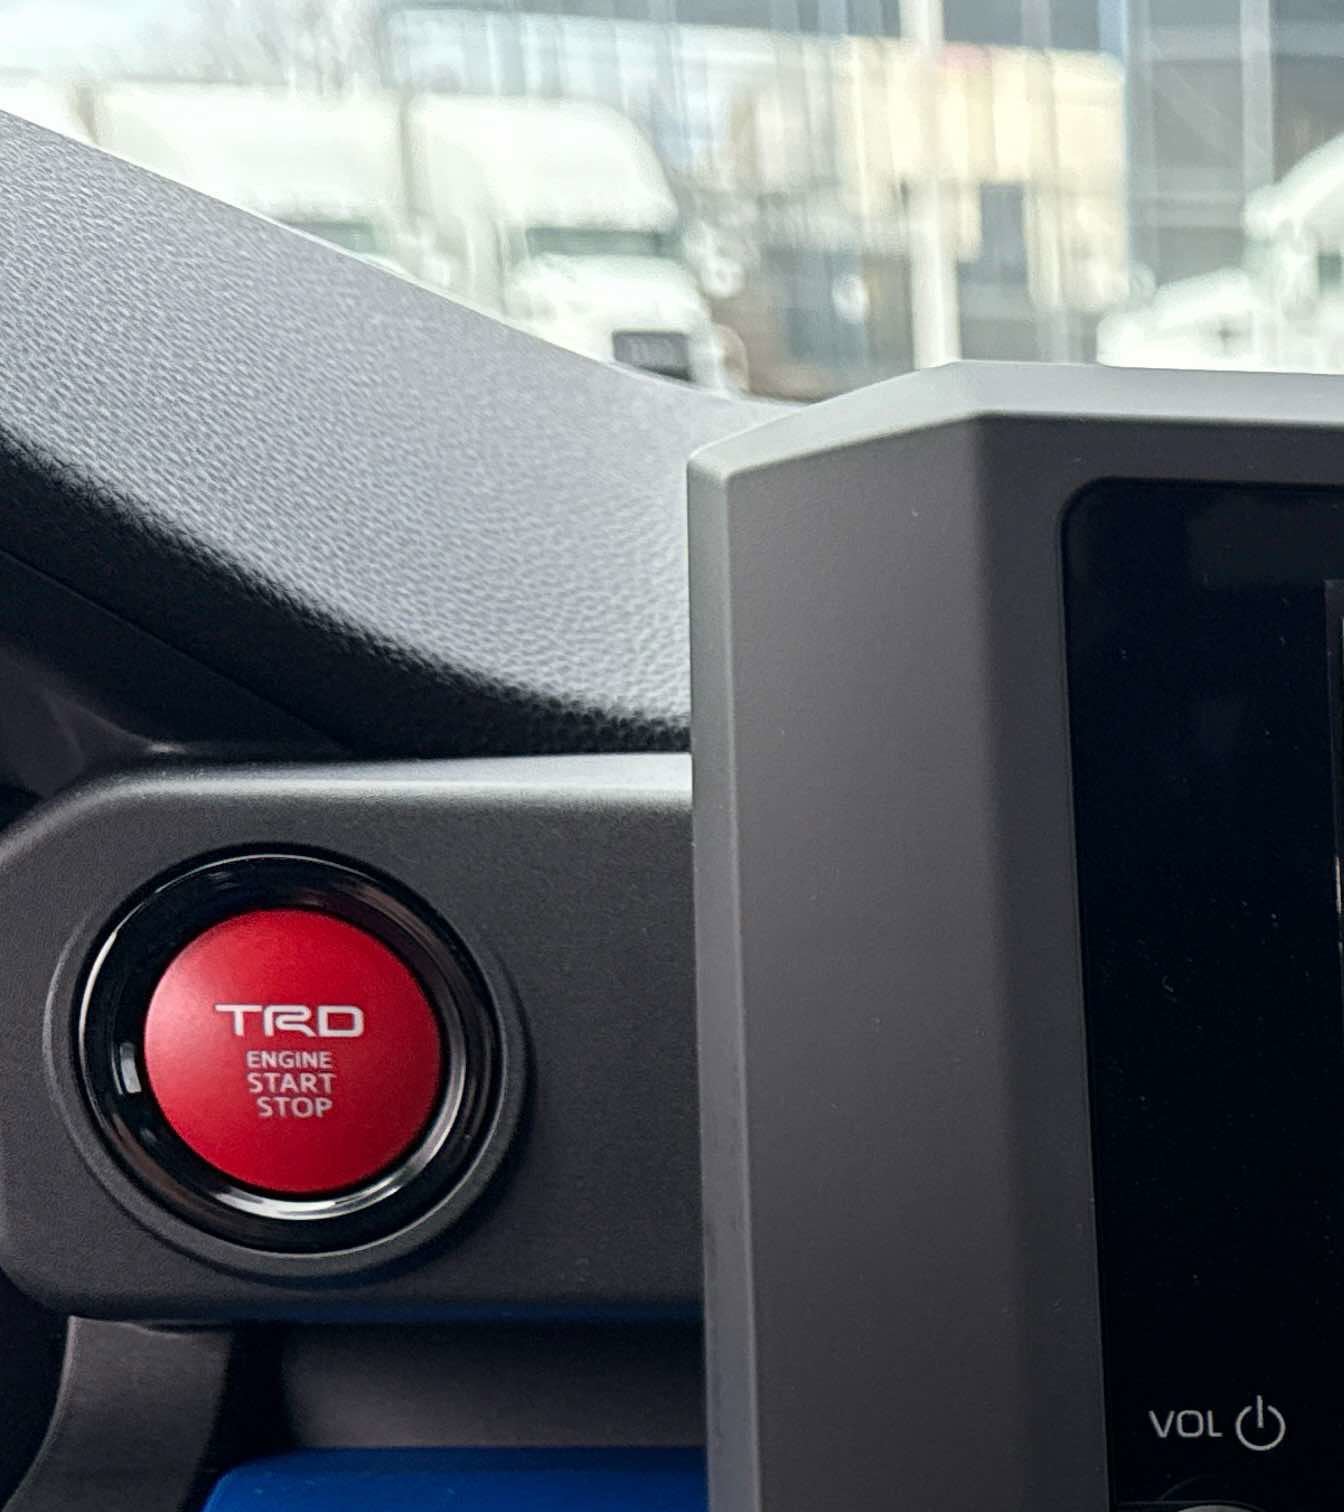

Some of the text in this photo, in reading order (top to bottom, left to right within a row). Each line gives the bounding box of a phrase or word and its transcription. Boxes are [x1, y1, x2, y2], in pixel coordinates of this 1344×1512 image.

[214, 1003, 365, 1038] TRD
[246, 1050, 333, 1070] ENGINE
[246, 1072, 337, 1094] START
[256, 1096, 333, 1119] STOP
[1148, 1410, 1223, 1438] VOL
